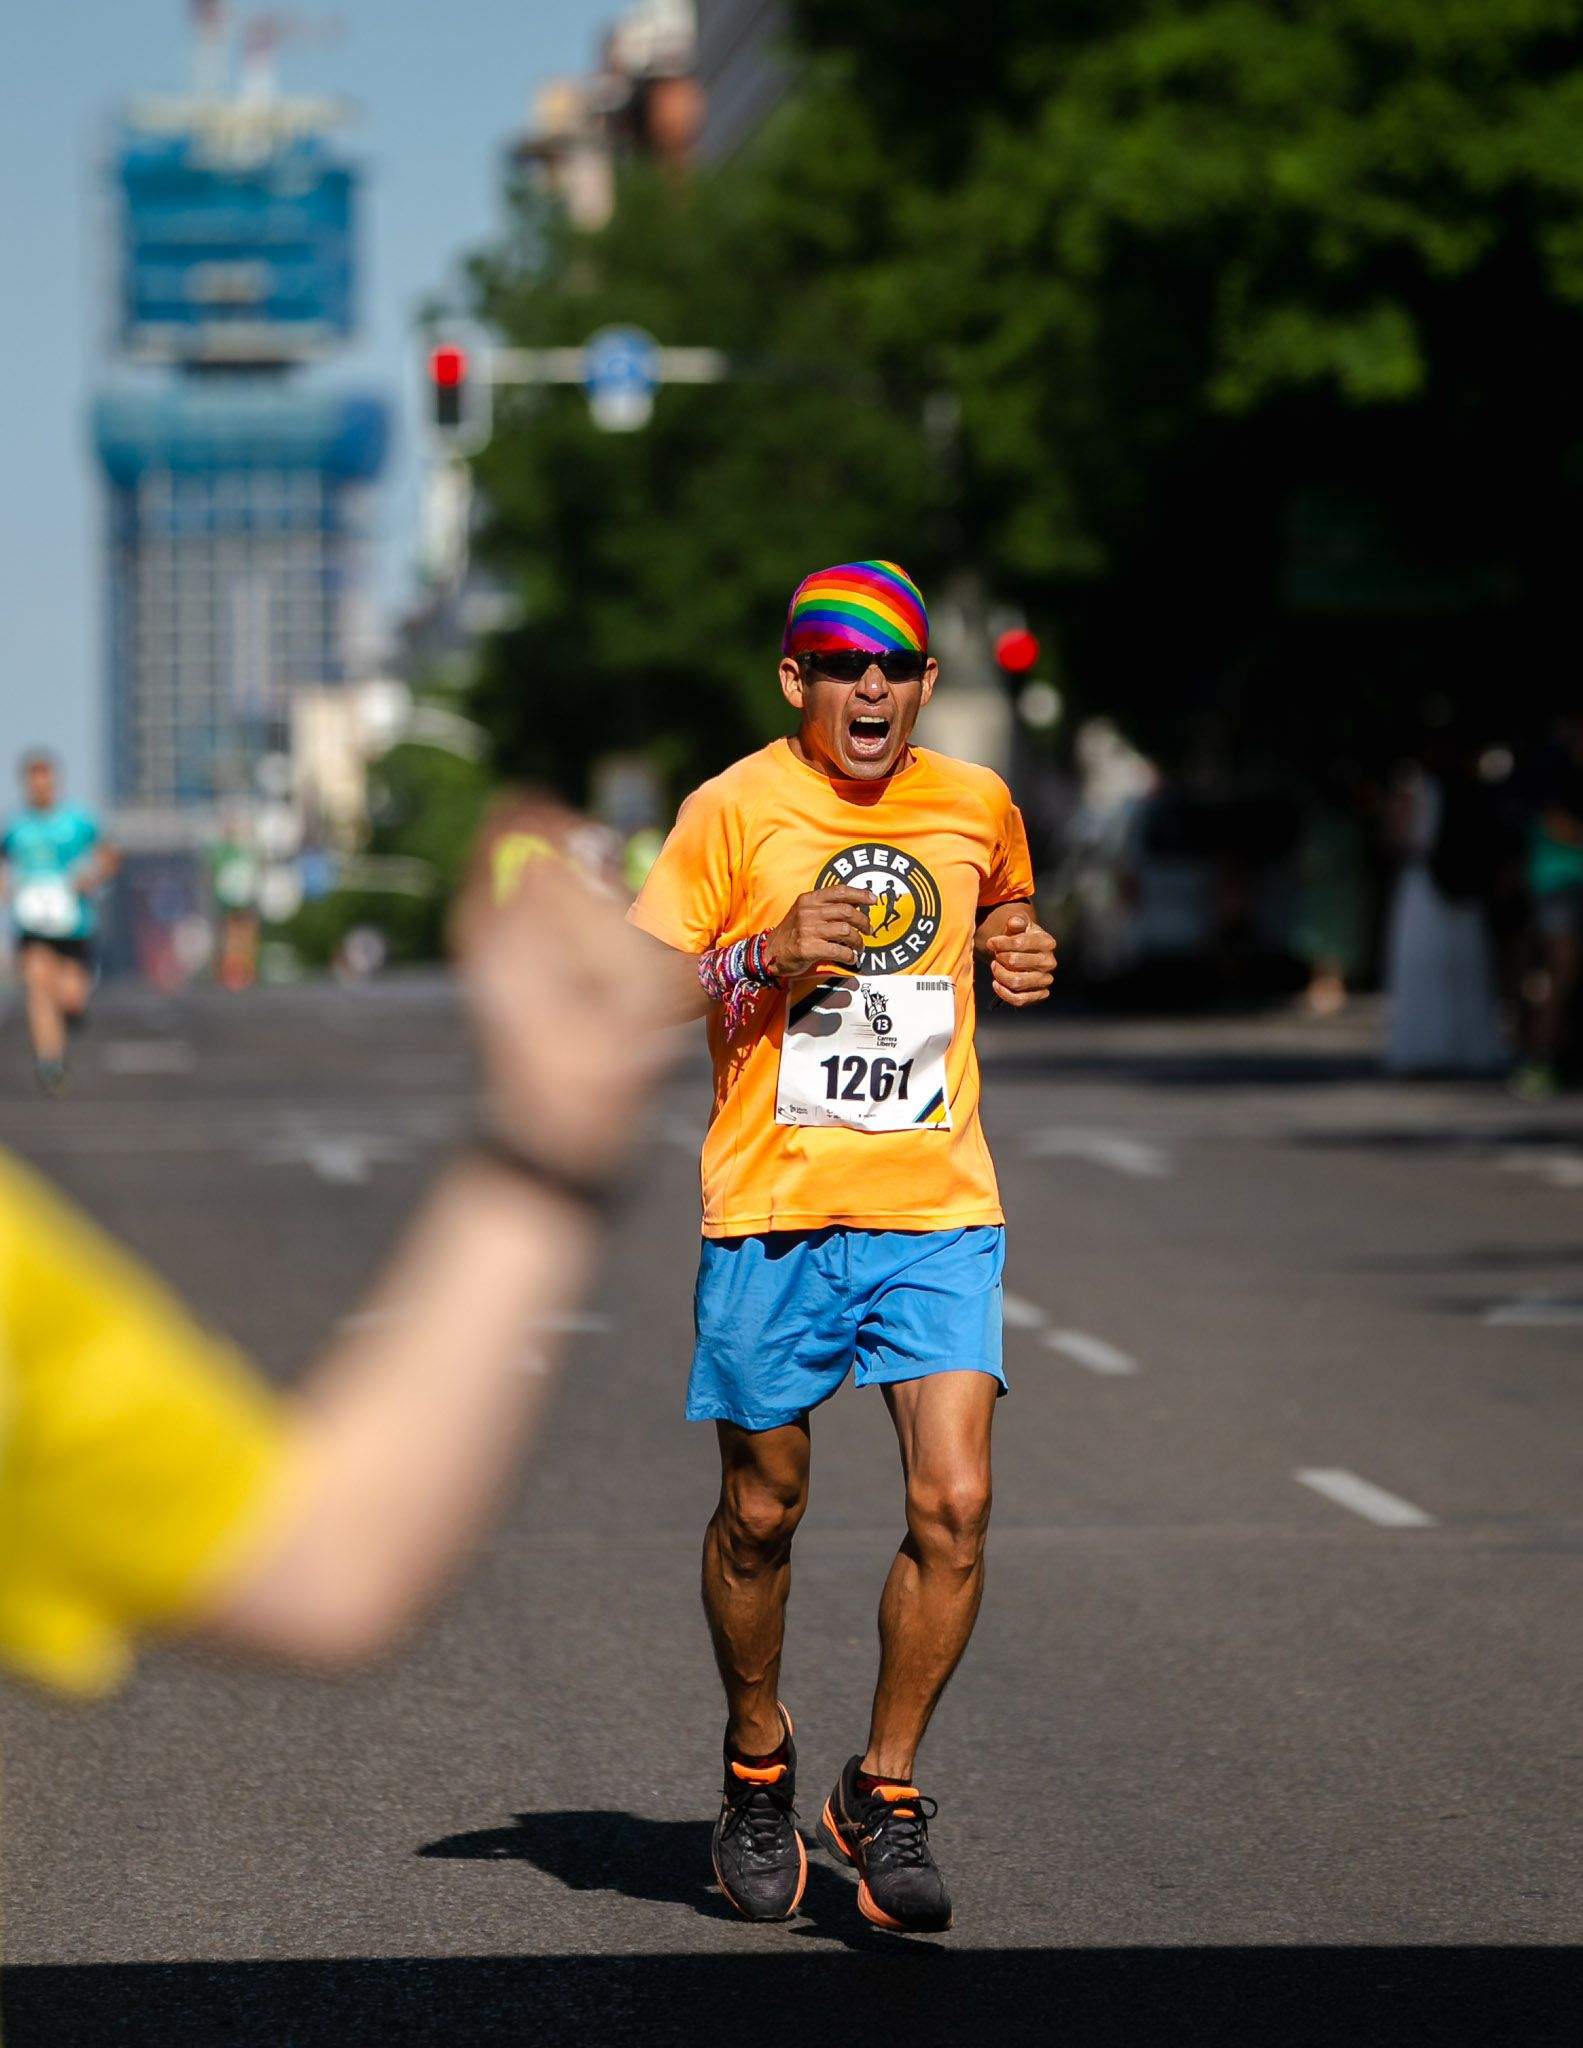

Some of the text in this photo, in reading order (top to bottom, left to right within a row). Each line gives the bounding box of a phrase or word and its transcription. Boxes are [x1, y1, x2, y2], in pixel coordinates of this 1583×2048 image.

[833, 848, 910, 878] BEER
[852, 918, 934, 971] NERS
[876, 1019, 889, 1031] 13
[877, 1041, 898, 1049] Liberty
[820, 1055, 914, 1102] 1261
